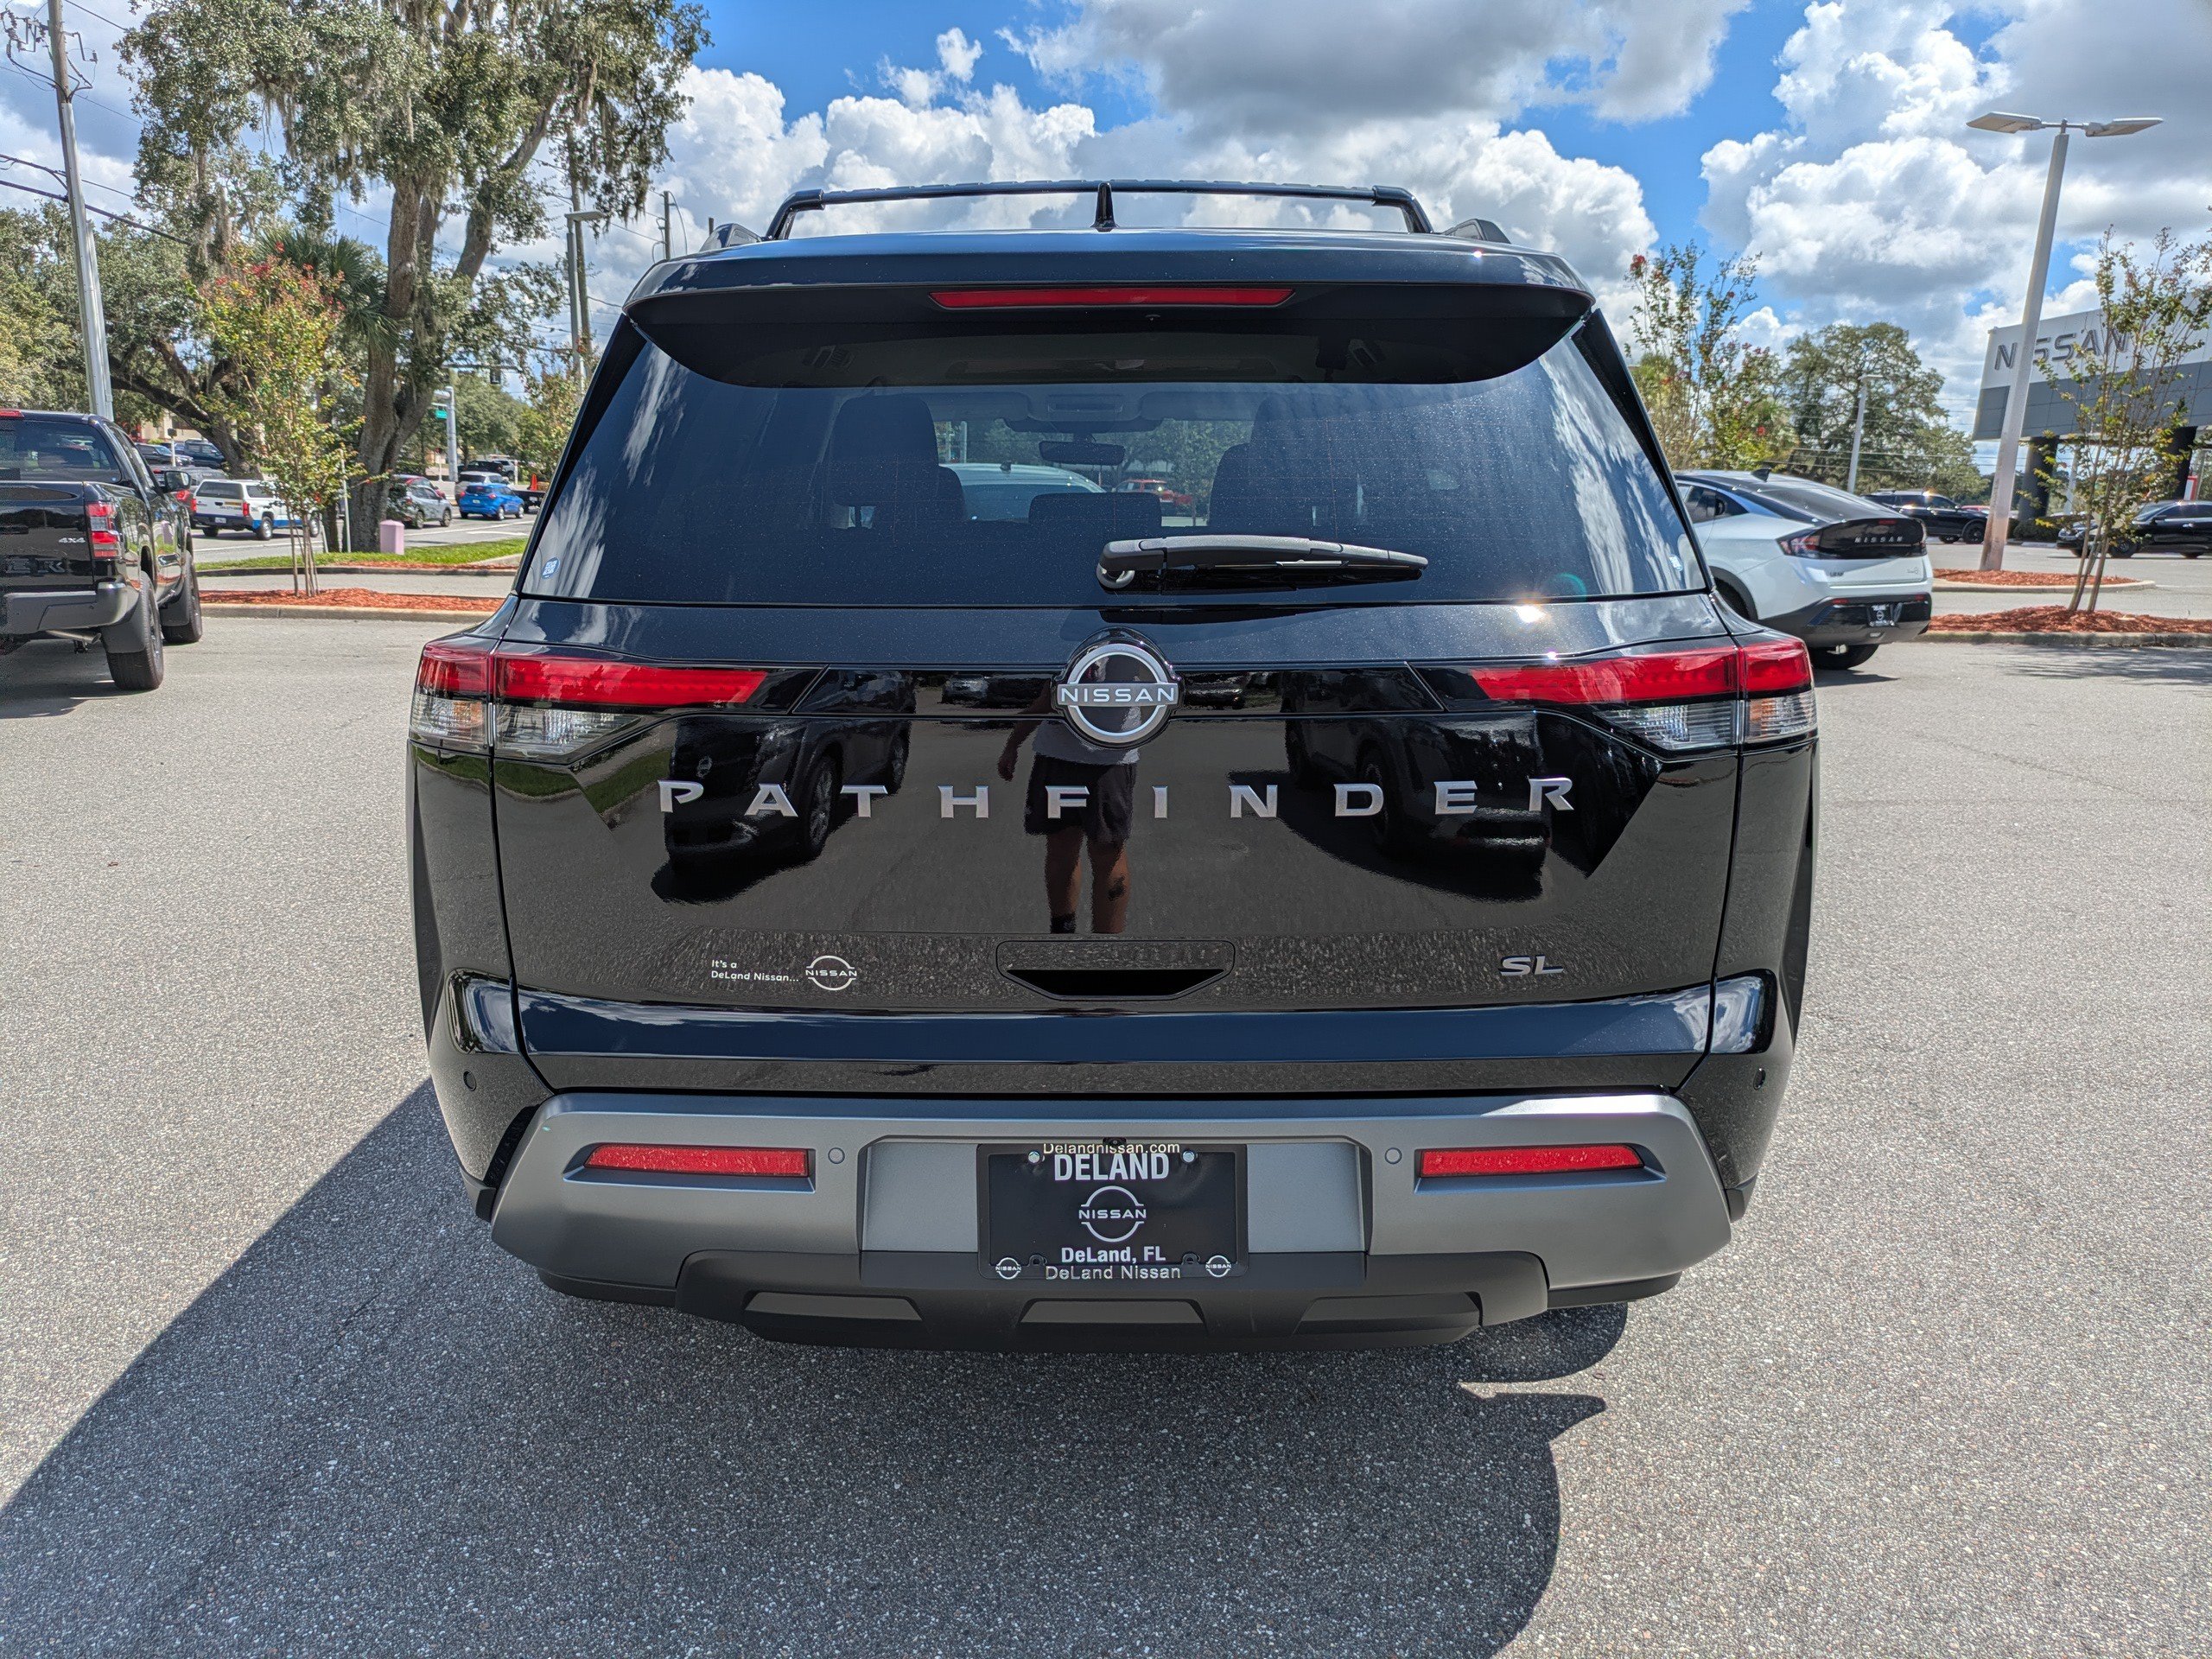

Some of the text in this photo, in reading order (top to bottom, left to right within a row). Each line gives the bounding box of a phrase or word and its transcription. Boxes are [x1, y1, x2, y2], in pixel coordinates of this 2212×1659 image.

[1994, 328, 2129, 371] NSSAN
[1060, 687, 1175, 702] NISSAN
[657, 775, 1574, 819] PATHFINDER
[711, 959, 728, 969] It's
[1499, 955, 1564, 976] SL
[711, 970, 799, 982] DeLand Nissan...
[1054, 1153, 1170, 1181] DELAND
[1078, 1209, 1147, 1220] NISSAN
[1061, 1245, 1166, 1264] DeLand, FL
[1046, 1264, 1181, 1280] DeLand Nissan
